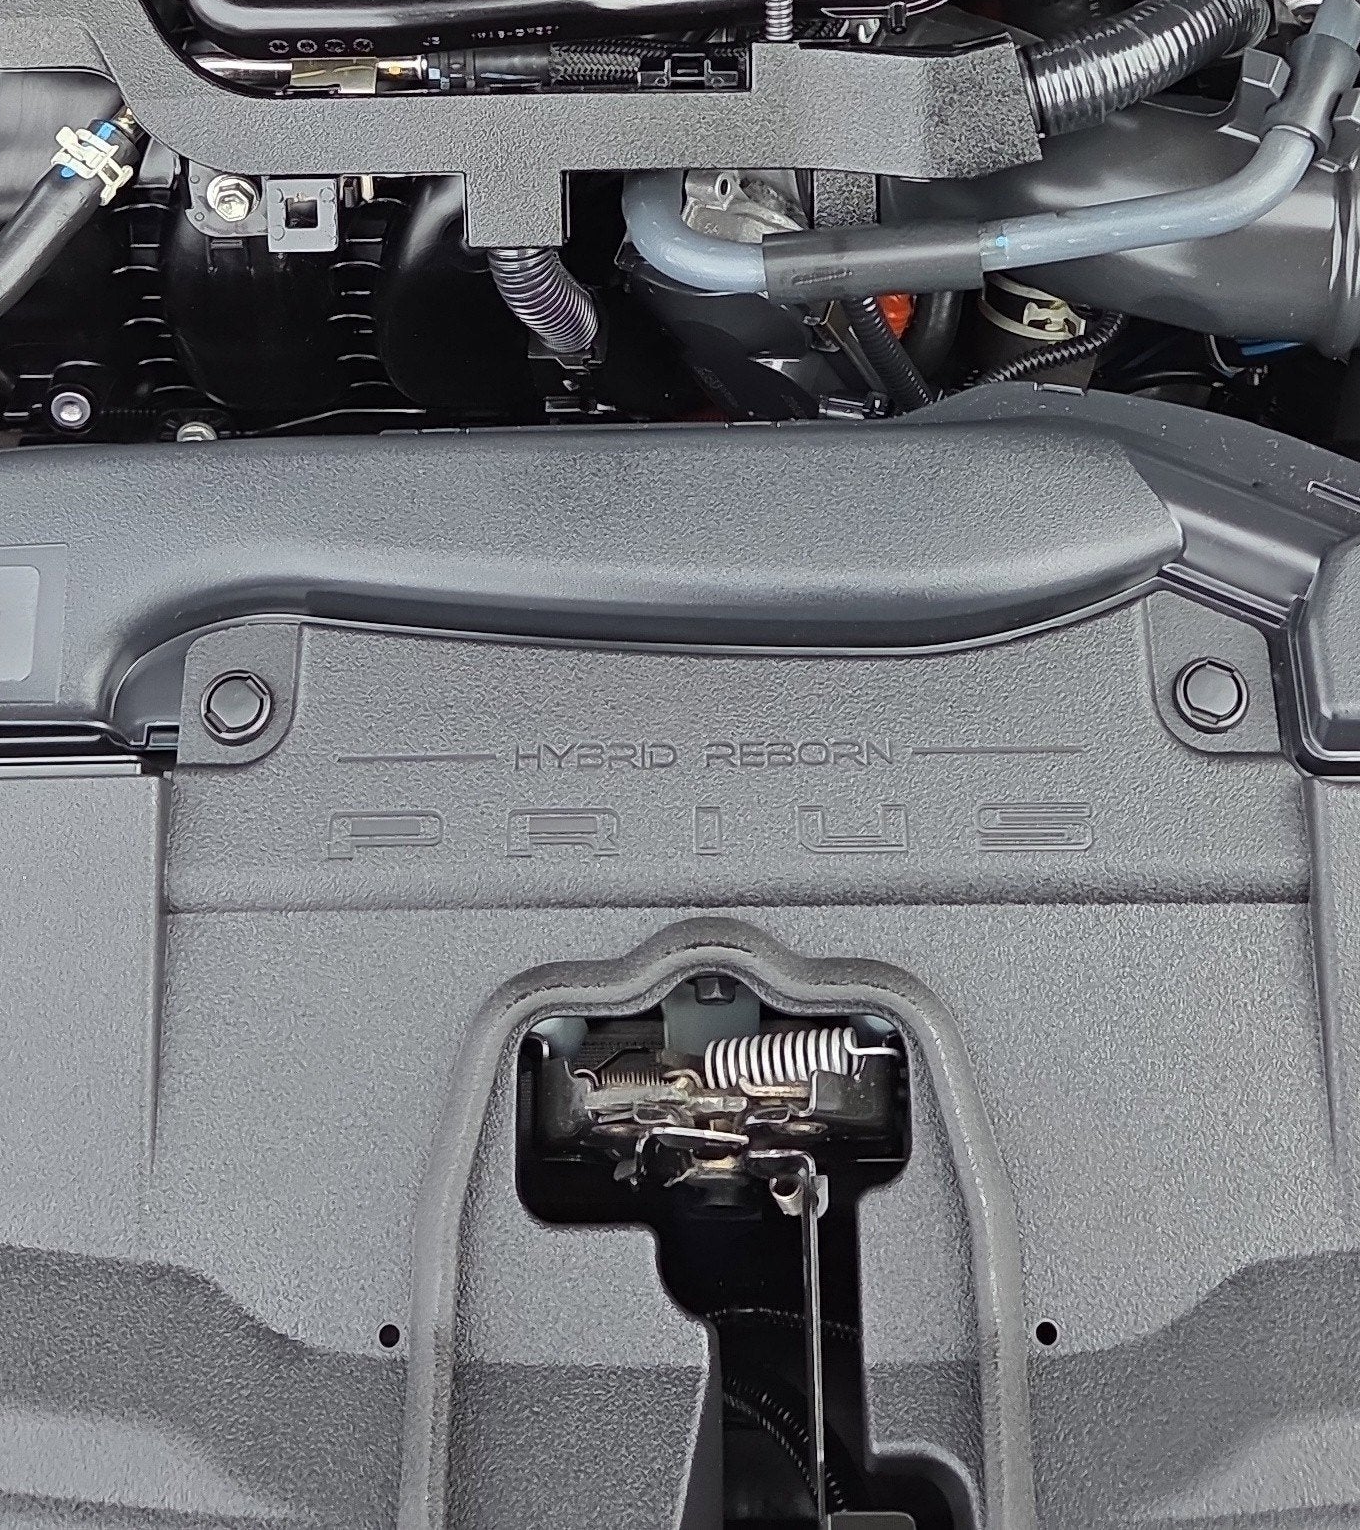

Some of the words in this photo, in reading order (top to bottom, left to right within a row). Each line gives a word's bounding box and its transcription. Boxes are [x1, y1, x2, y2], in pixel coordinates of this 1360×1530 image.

[515, 743, 678, 770] HYBRID
[706, 738, 895, 768] REBORN
[327, 800, 1096, 860] PRIUS
